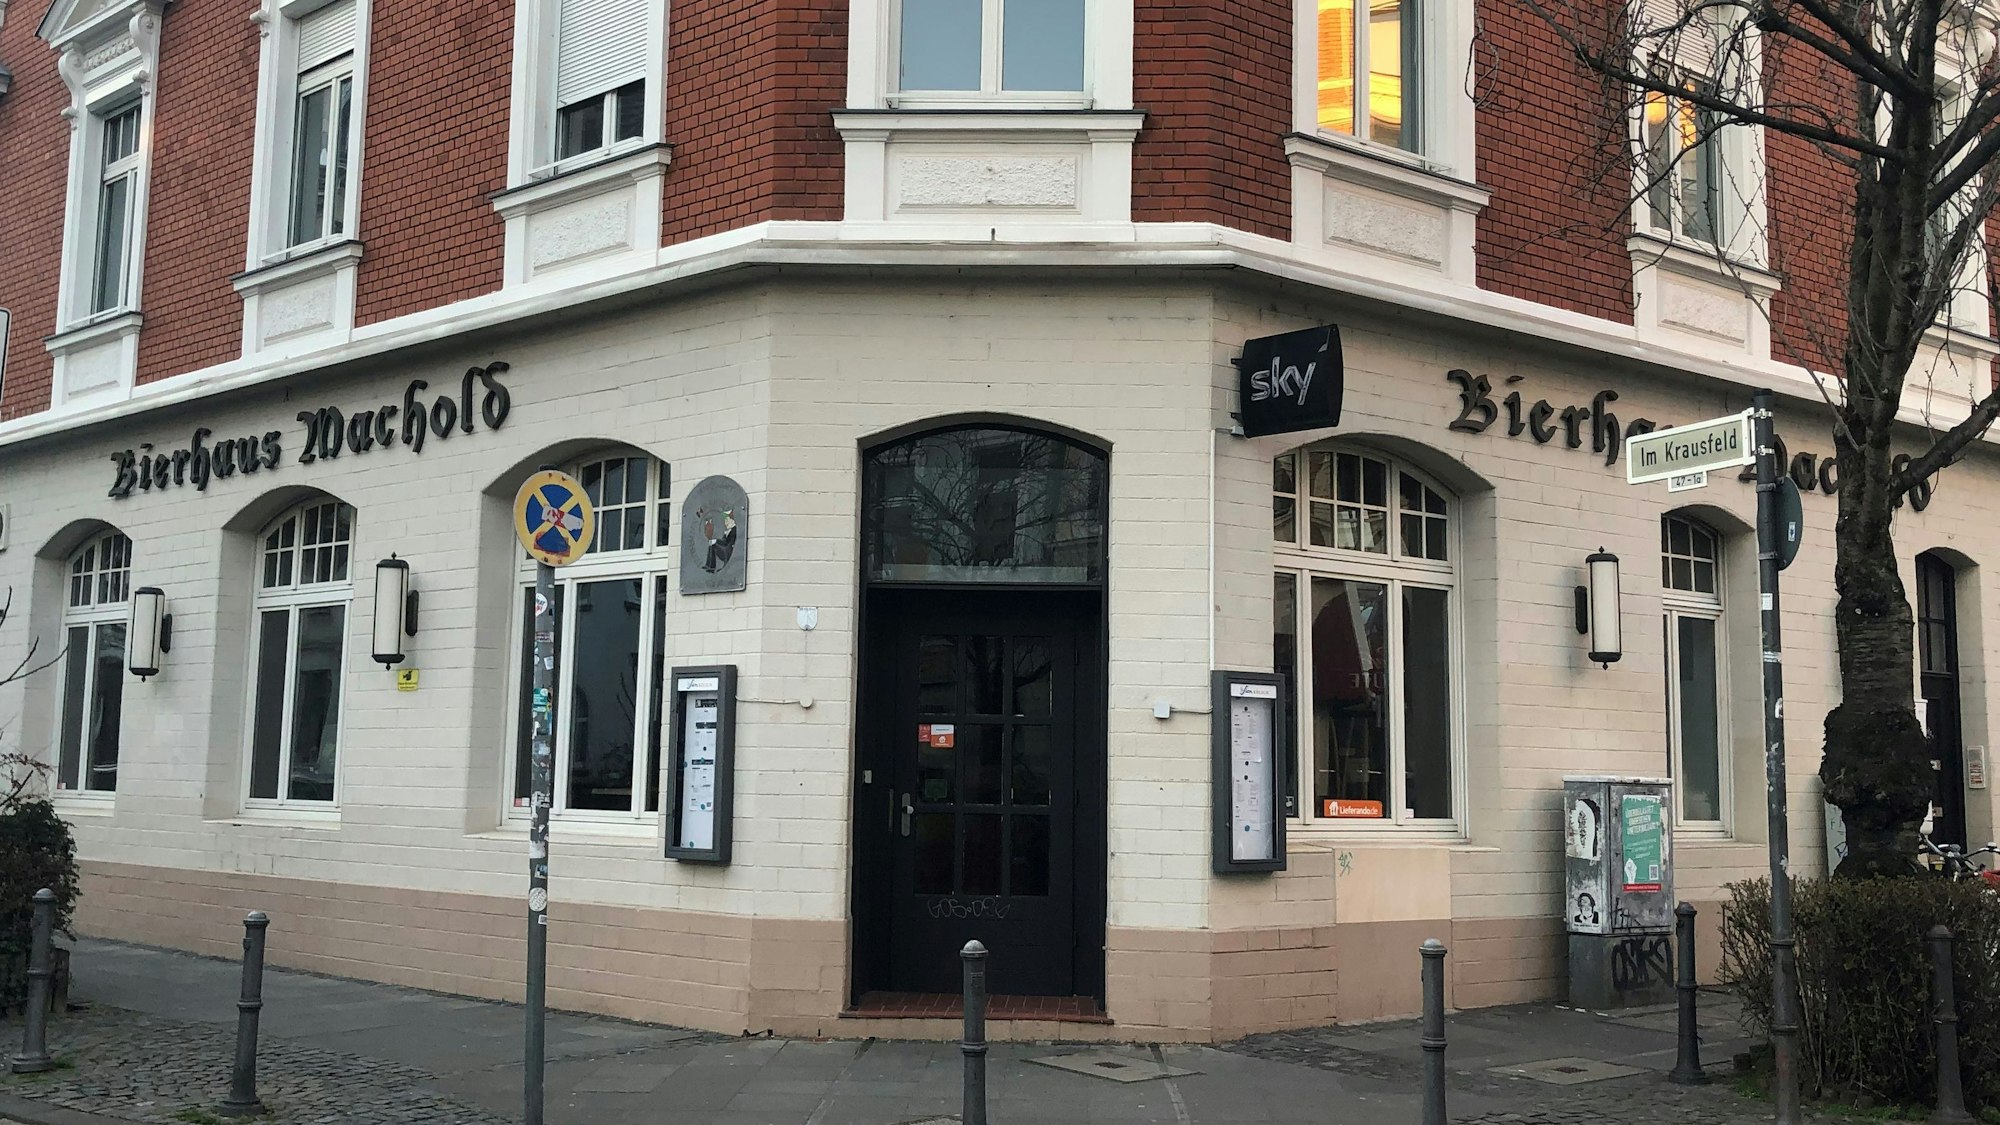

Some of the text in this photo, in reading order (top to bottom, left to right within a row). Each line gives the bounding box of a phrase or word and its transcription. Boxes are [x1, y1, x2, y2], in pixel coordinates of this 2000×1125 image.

[1250, 356, 1316, 406] sky
[108, 361, 510, 498] Bierhaus Machold
[1641, 428, 1737, 467] Im Krausfeld
